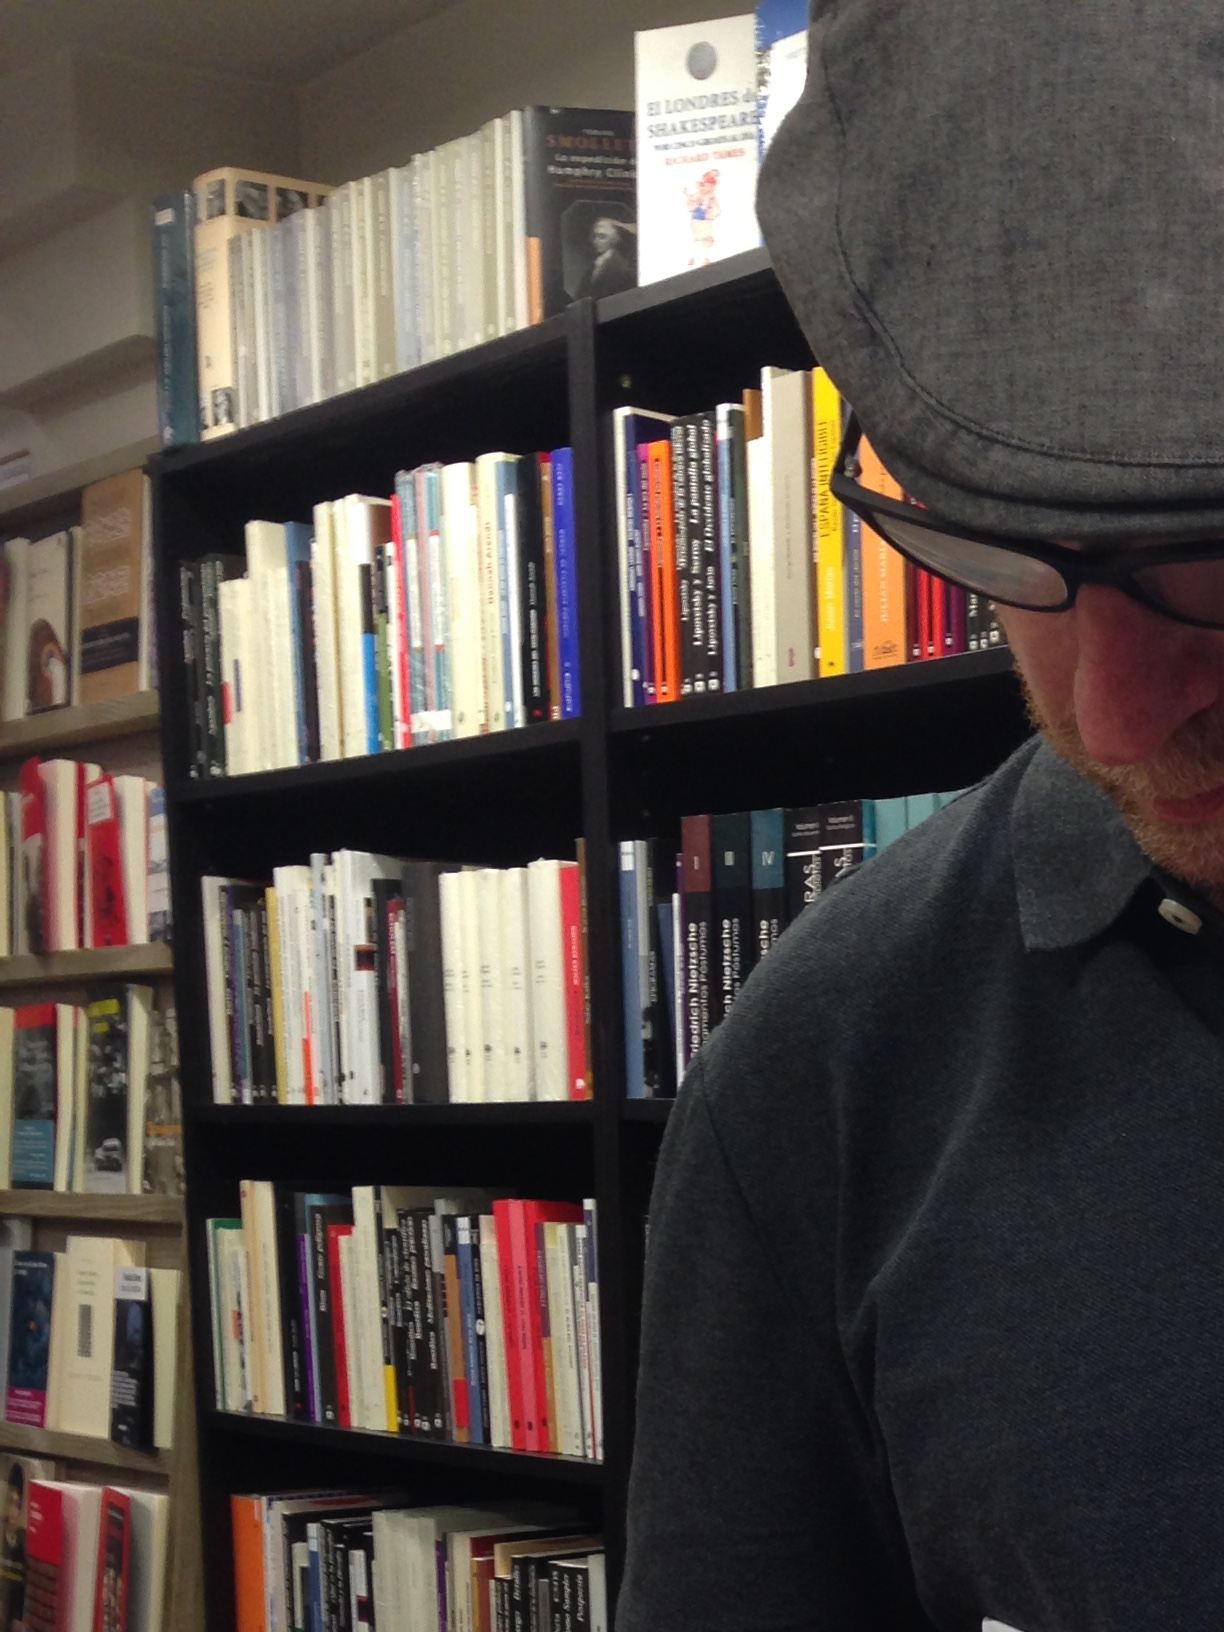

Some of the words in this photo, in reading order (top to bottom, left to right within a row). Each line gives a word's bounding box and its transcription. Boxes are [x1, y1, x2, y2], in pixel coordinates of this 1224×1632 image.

[665, 90, 739, 114] LONDRES
[686, 424, 700, 459] global
[700, 419, 715, 482] globalizado
[687, 461, 701, 506] pantalla
[703, 485, 714, 537] Occidente
[689, 509, 699, 524] La
[691, 586, 705, 644] Lipovetsky
[706, 601, 719, 655] Lipovetsky
[686, 922, 699, 993] Nietzsche
[697, 920, 709, 981] Póstumos
[720, 918, 733, 990] Nietzsche
[729, 917, 741, 978] Póstumos
